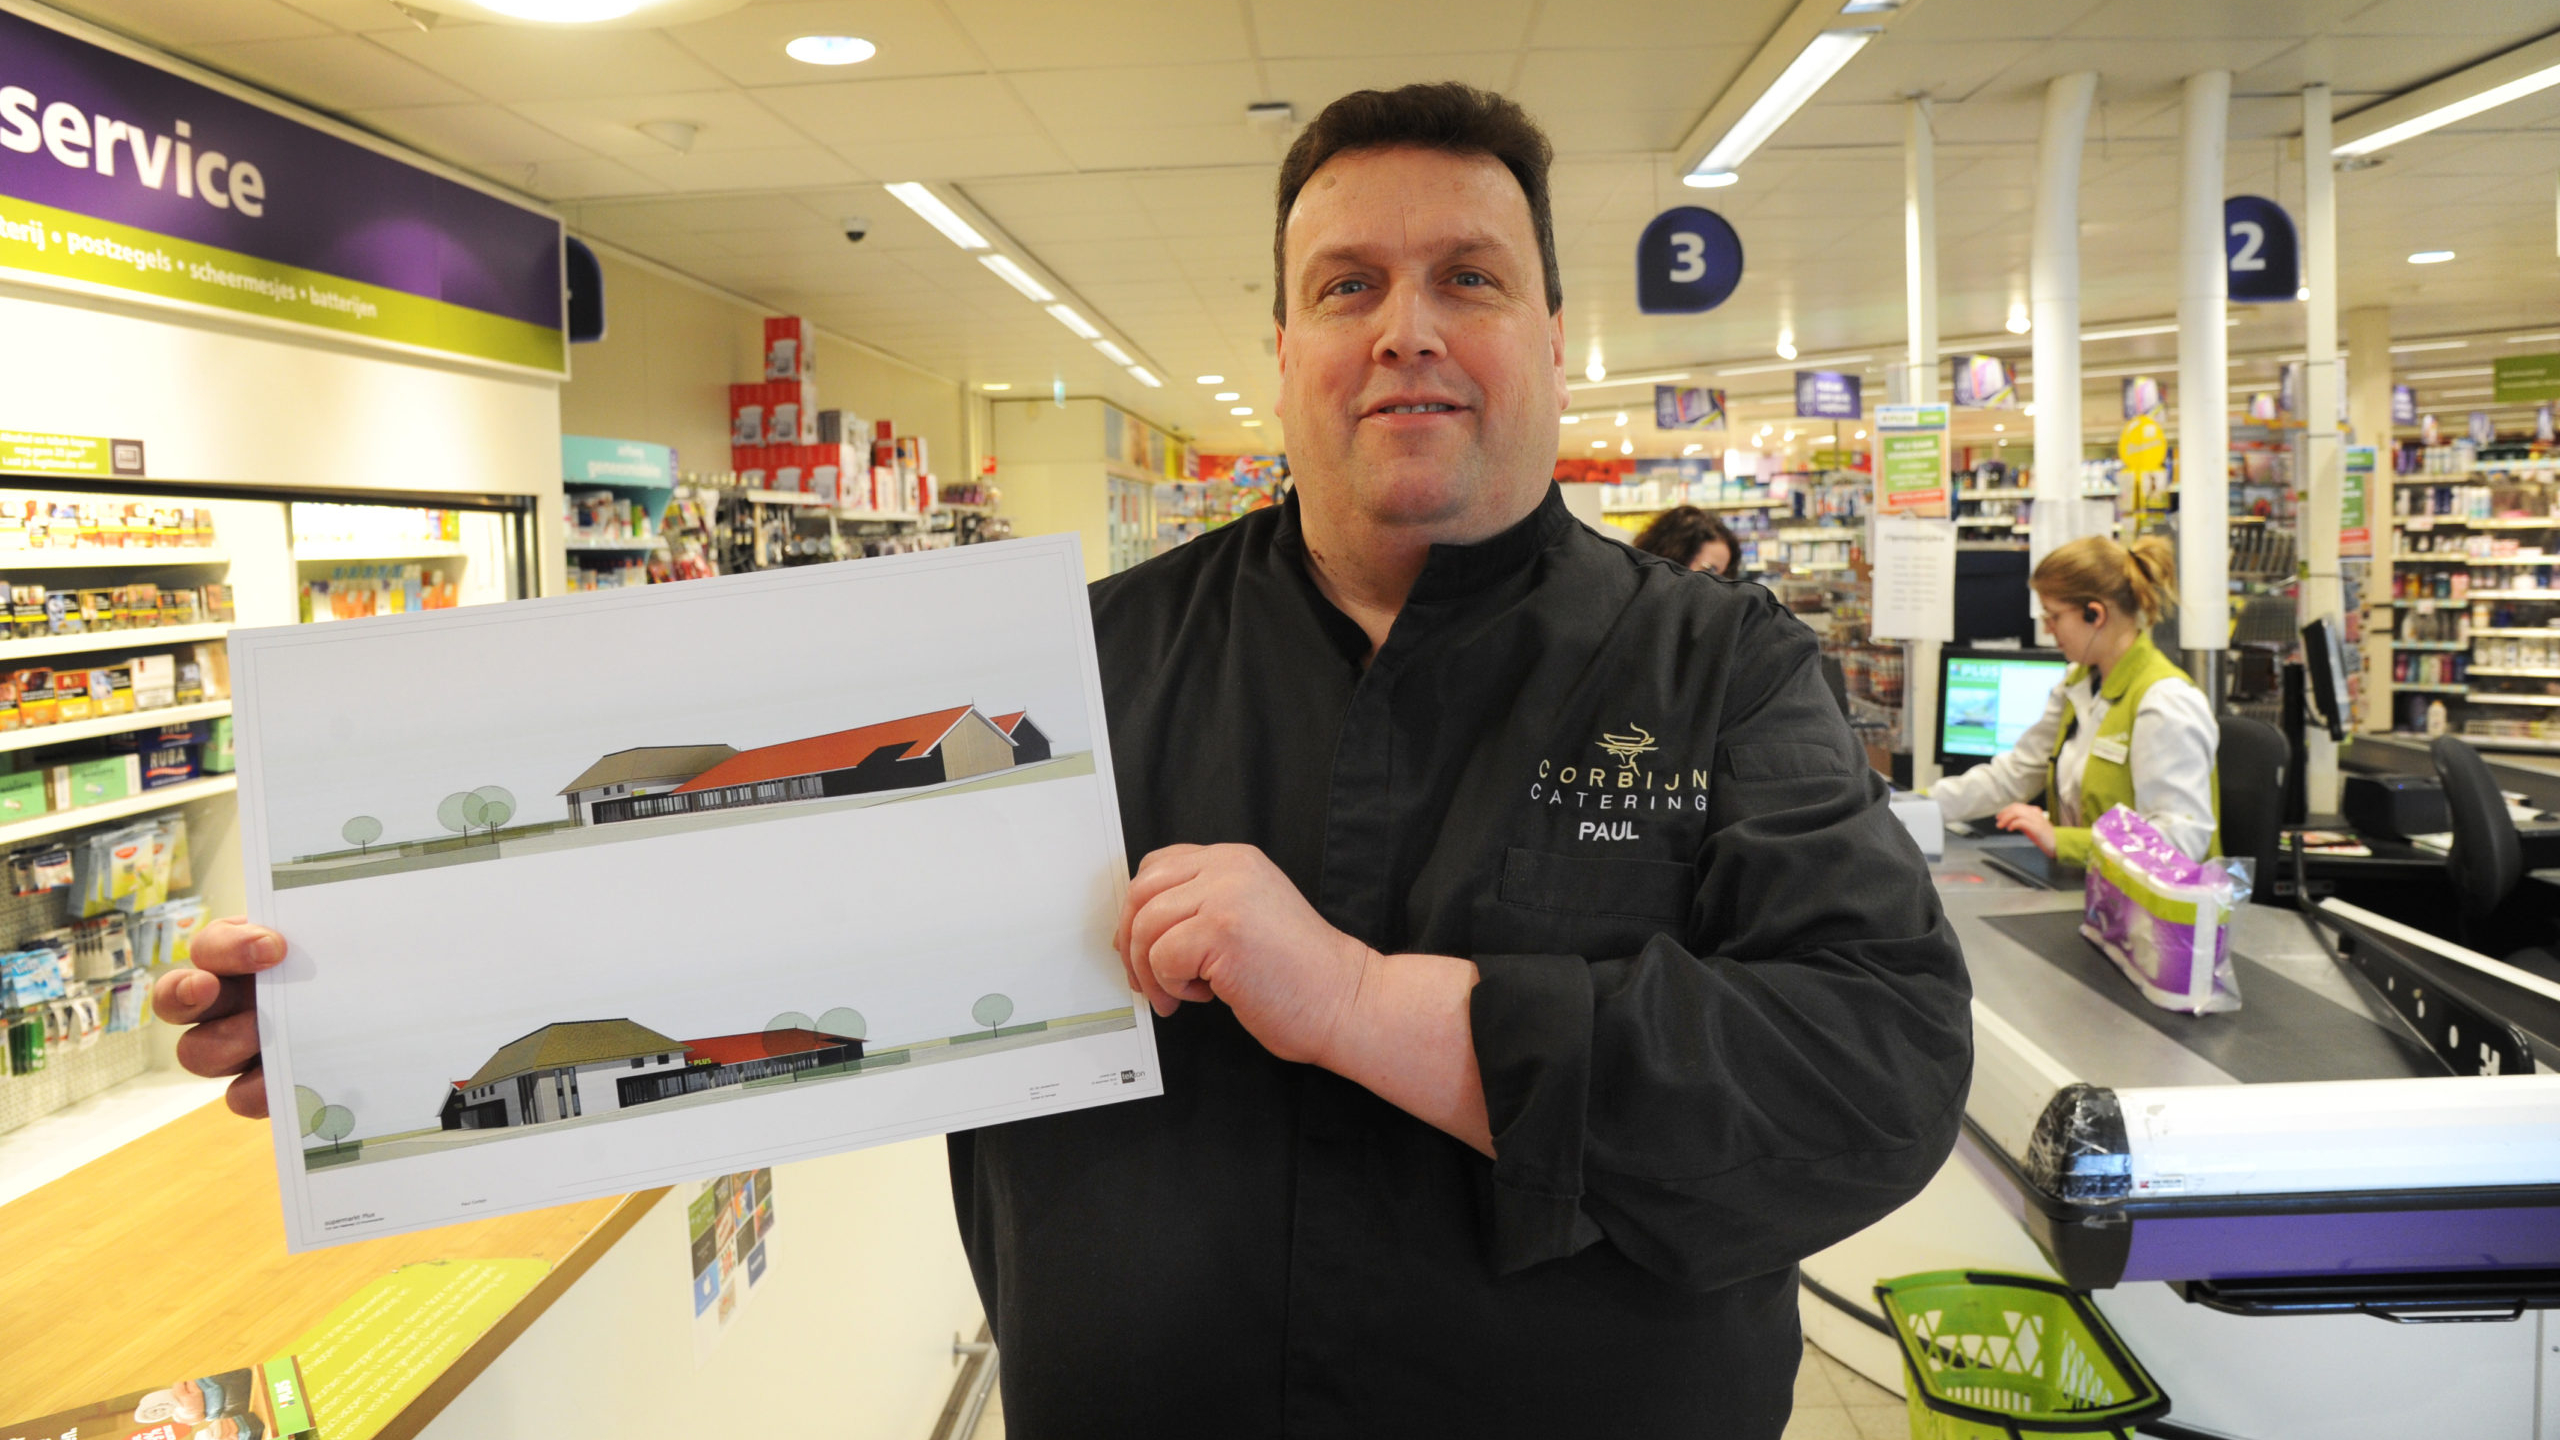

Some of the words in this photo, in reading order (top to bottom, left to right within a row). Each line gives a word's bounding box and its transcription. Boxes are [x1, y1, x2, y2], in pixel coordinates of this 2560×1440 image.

[0, 85, 265, 217] service
[1669, 231, 1707, 283] 3
[2230, 221, 2266, 271] 2
[67, 231, 172, 272] postzegels
[190, 261, 296, 302] scheermesjes
[309, 286, 377, 319] batterijen
[150, 748, 187, 768] RUBA
[1539, 759, 1707, 791] CORBIJN
[1530, 783, 1707, 811] CATERING
[1579, 821, 1639, 841] PAUL
